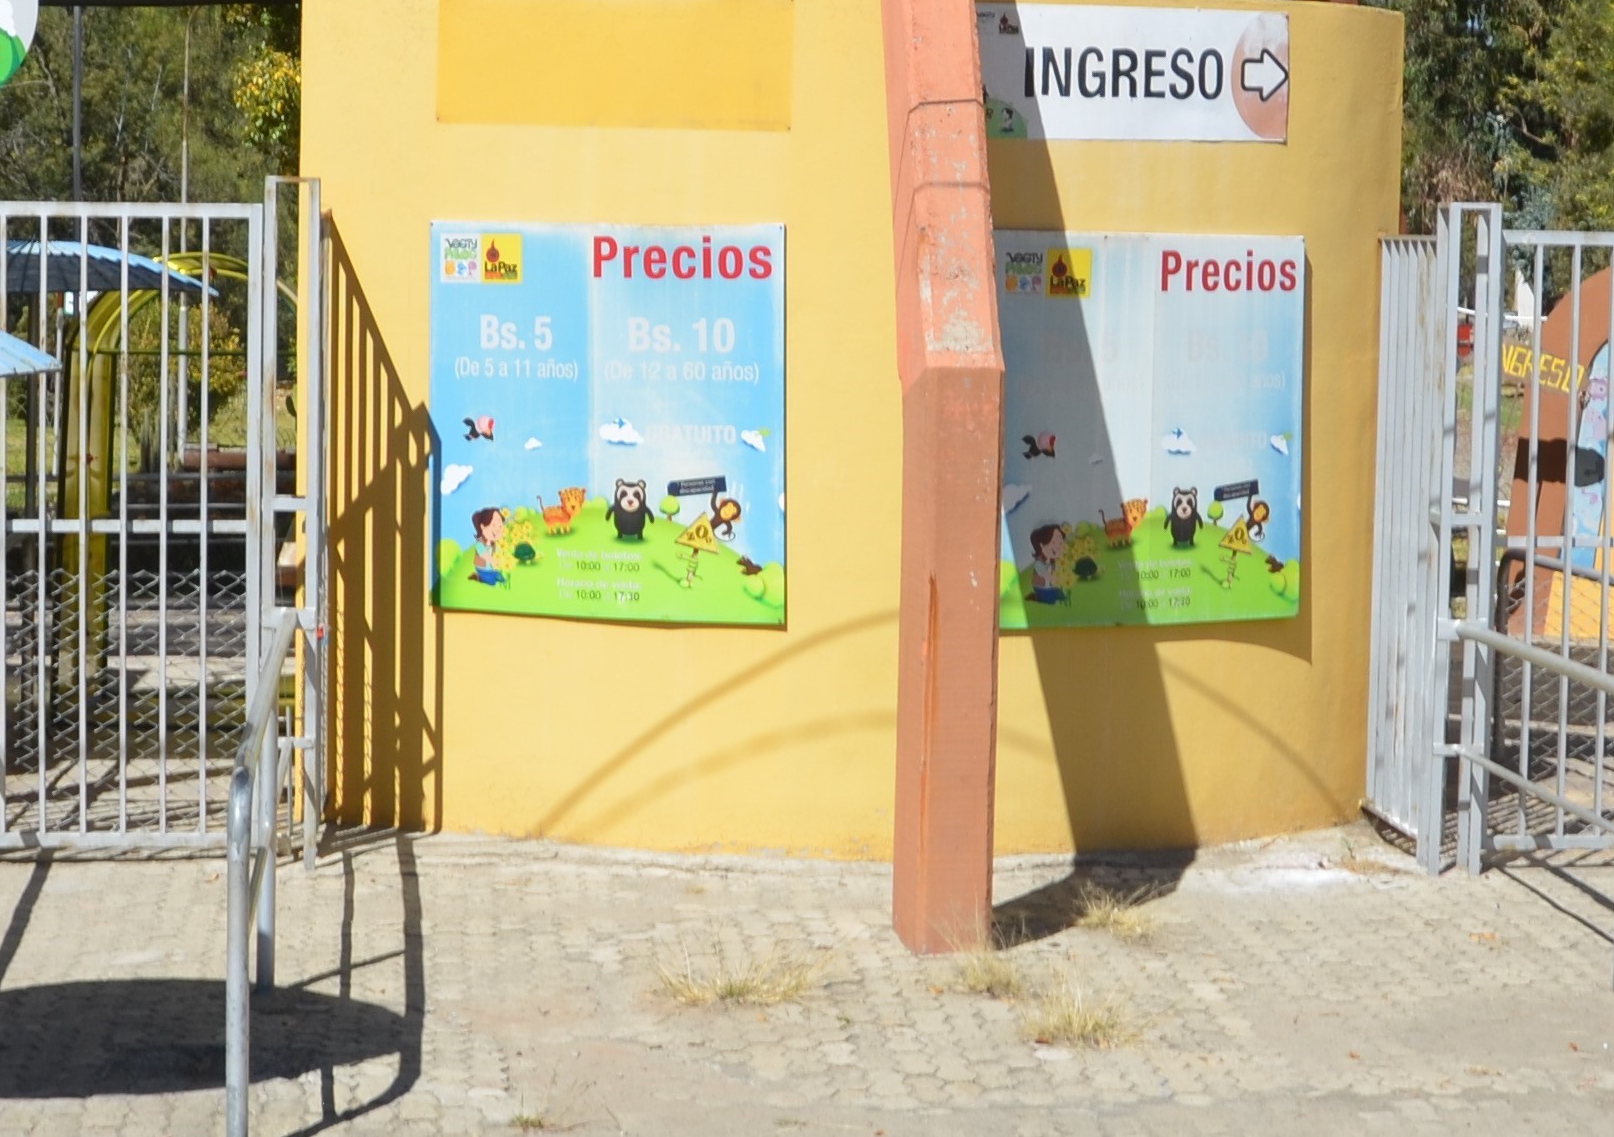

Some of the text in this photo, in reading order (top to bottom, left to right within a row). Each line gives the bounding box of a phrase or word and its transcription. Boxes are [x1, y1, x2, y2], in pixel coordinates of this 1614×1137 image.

[1024, 46, 1224, 100] INGRESO
[593, 235, 773, 280] Precios
[1160, 249, 1297, 293] Precios
[480, 314, 553, 351] Bs. 5
[627, 316, 735, 354] Bs. 10
[454, 356, 579, 382] (De 5 a 11 años)
[639, 361, 661, 381] 12
[666, 365, 677, 381] a
[712, 360, 760, 384] años)
[1501, 342, 1585, 394] NGRESO
